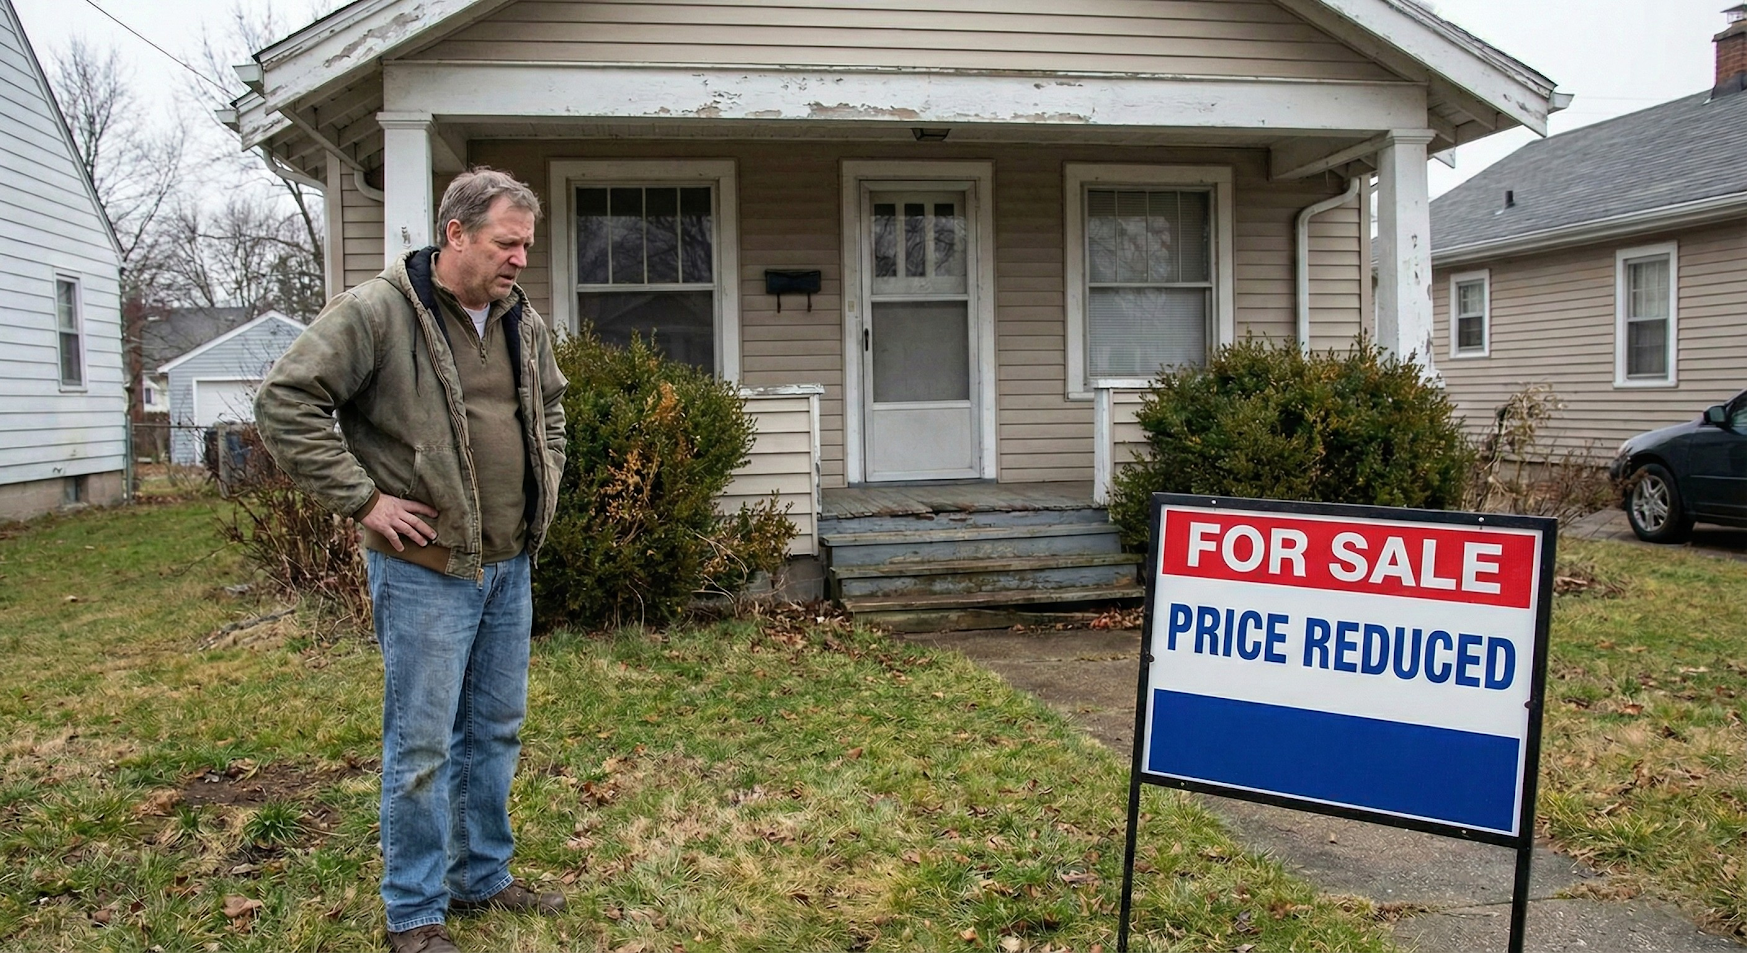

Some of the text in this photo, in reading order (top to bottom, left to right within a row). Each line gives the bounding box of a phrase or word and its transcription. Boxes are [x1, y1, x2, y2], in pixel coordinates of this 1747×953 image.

[1187, 521, 1503, 594] FOR SALE
[1167, 602, 1517, 691] PRICE REDUCED
